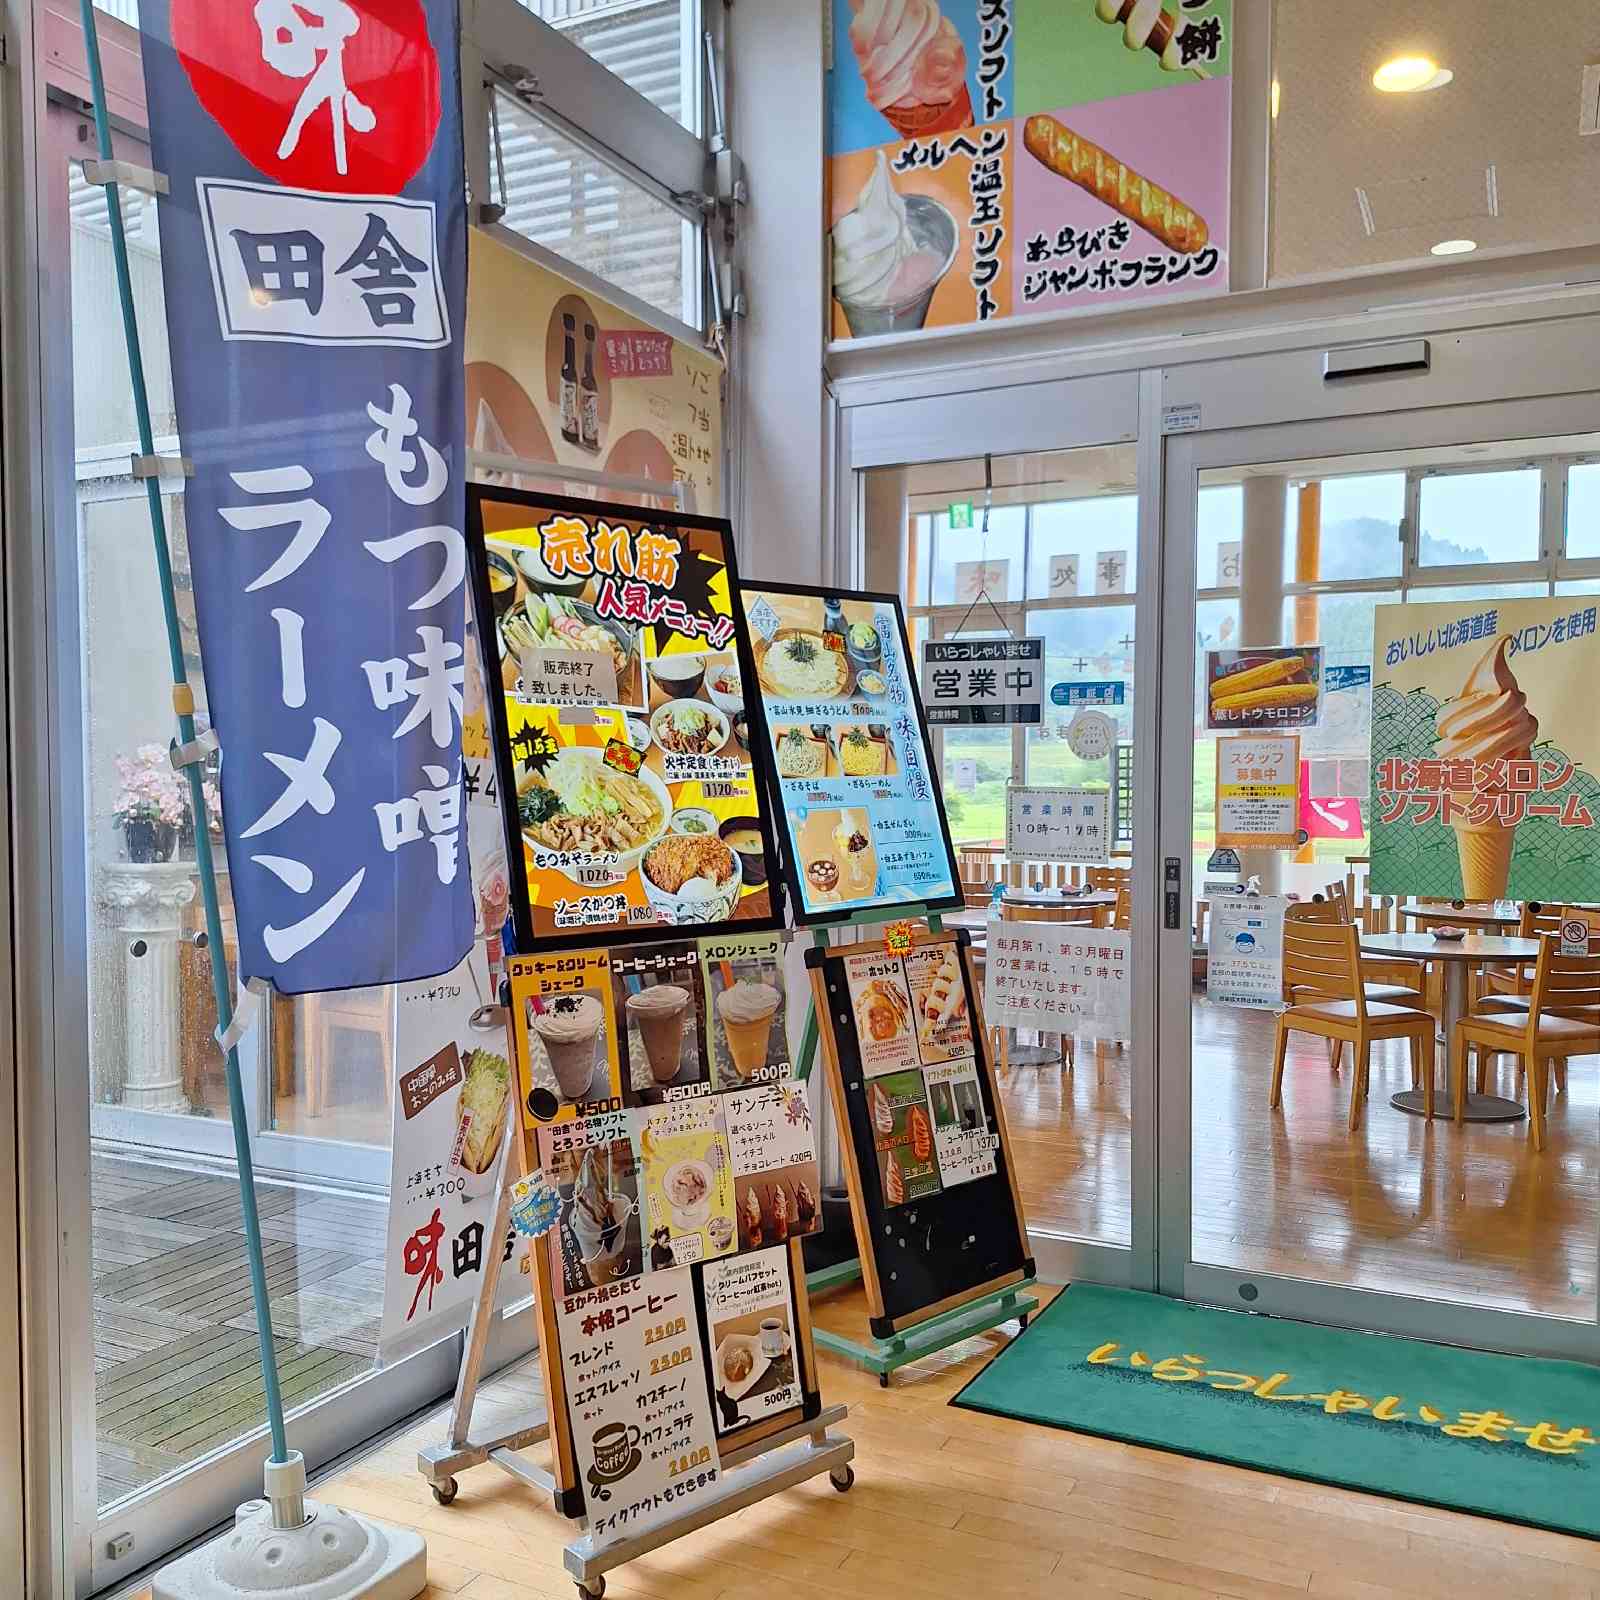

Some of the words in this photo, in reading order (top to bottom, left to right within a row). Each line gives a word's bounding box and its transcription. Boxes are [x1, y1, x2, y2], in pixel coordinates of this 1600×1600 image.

[1026, 220, 1130, 263] あらびき
[229, 213, 429, 328] 田舎
[1024, 249, 1218, 301] ジャンボフランク
[541, 516, 681, 589] 売れ筋
[1386, 609, 1498, 666] おいしい北海道産
[1508, 607, 1597, 658] メロンを使用
[935, 645, 1031, 659] いらっしゃいませ
[544, 660, 594, 678] 販売終了
[532, 680, 602, 698] 致しました。
[933, 667, 1032, 698] 営業中
[217, 465, 366, 963] ラーメン
[1214, 706, 1315, 722] 蒸しトウモロコシ
[1231, 752, 1284, 764] スタッフ
[1237, 768, 1277, 781] 募集中
[1376, 758, 1577, 792] 北海道メロン
[1021, 804, 1094, 816] 営業時間
[1378, 792, 1594, 827] ソフトクリーム
[556, 895, 626, 914] ソースかつ丼
[705, 943, 778, 958] メロンシェーク
[612, 952, 697, 973] コーヒーシェーク
[540, 976, 584, 992] シェーク
[751, 1063, 791, 1082] 500円
[662, 1082, 712, 1103] ¥500円
[576, 1097, 623, 1118] ¥500
[731, 1120, 774, 1135] 選べるソース
[552, 1127, 627, 1152] とろっとソフト
[744, 1156, 784, 1171] チョコレート
[789, 1151, 812, 1163] 420円
[580, 1292, 678, 1337] 本格コーヒー
[574, 1370, 640, 1407] エスプレッソ
[764, 1388, 792, 1407] 500円
[1086, 1342, 1597, 1455] いらっしゃいませ
[584, 1407, 604, 1421] ホット
[641, 1413, 694, 1446] カフェラテ
[595, 1468, 717, 1534] テイクアウトもできます
